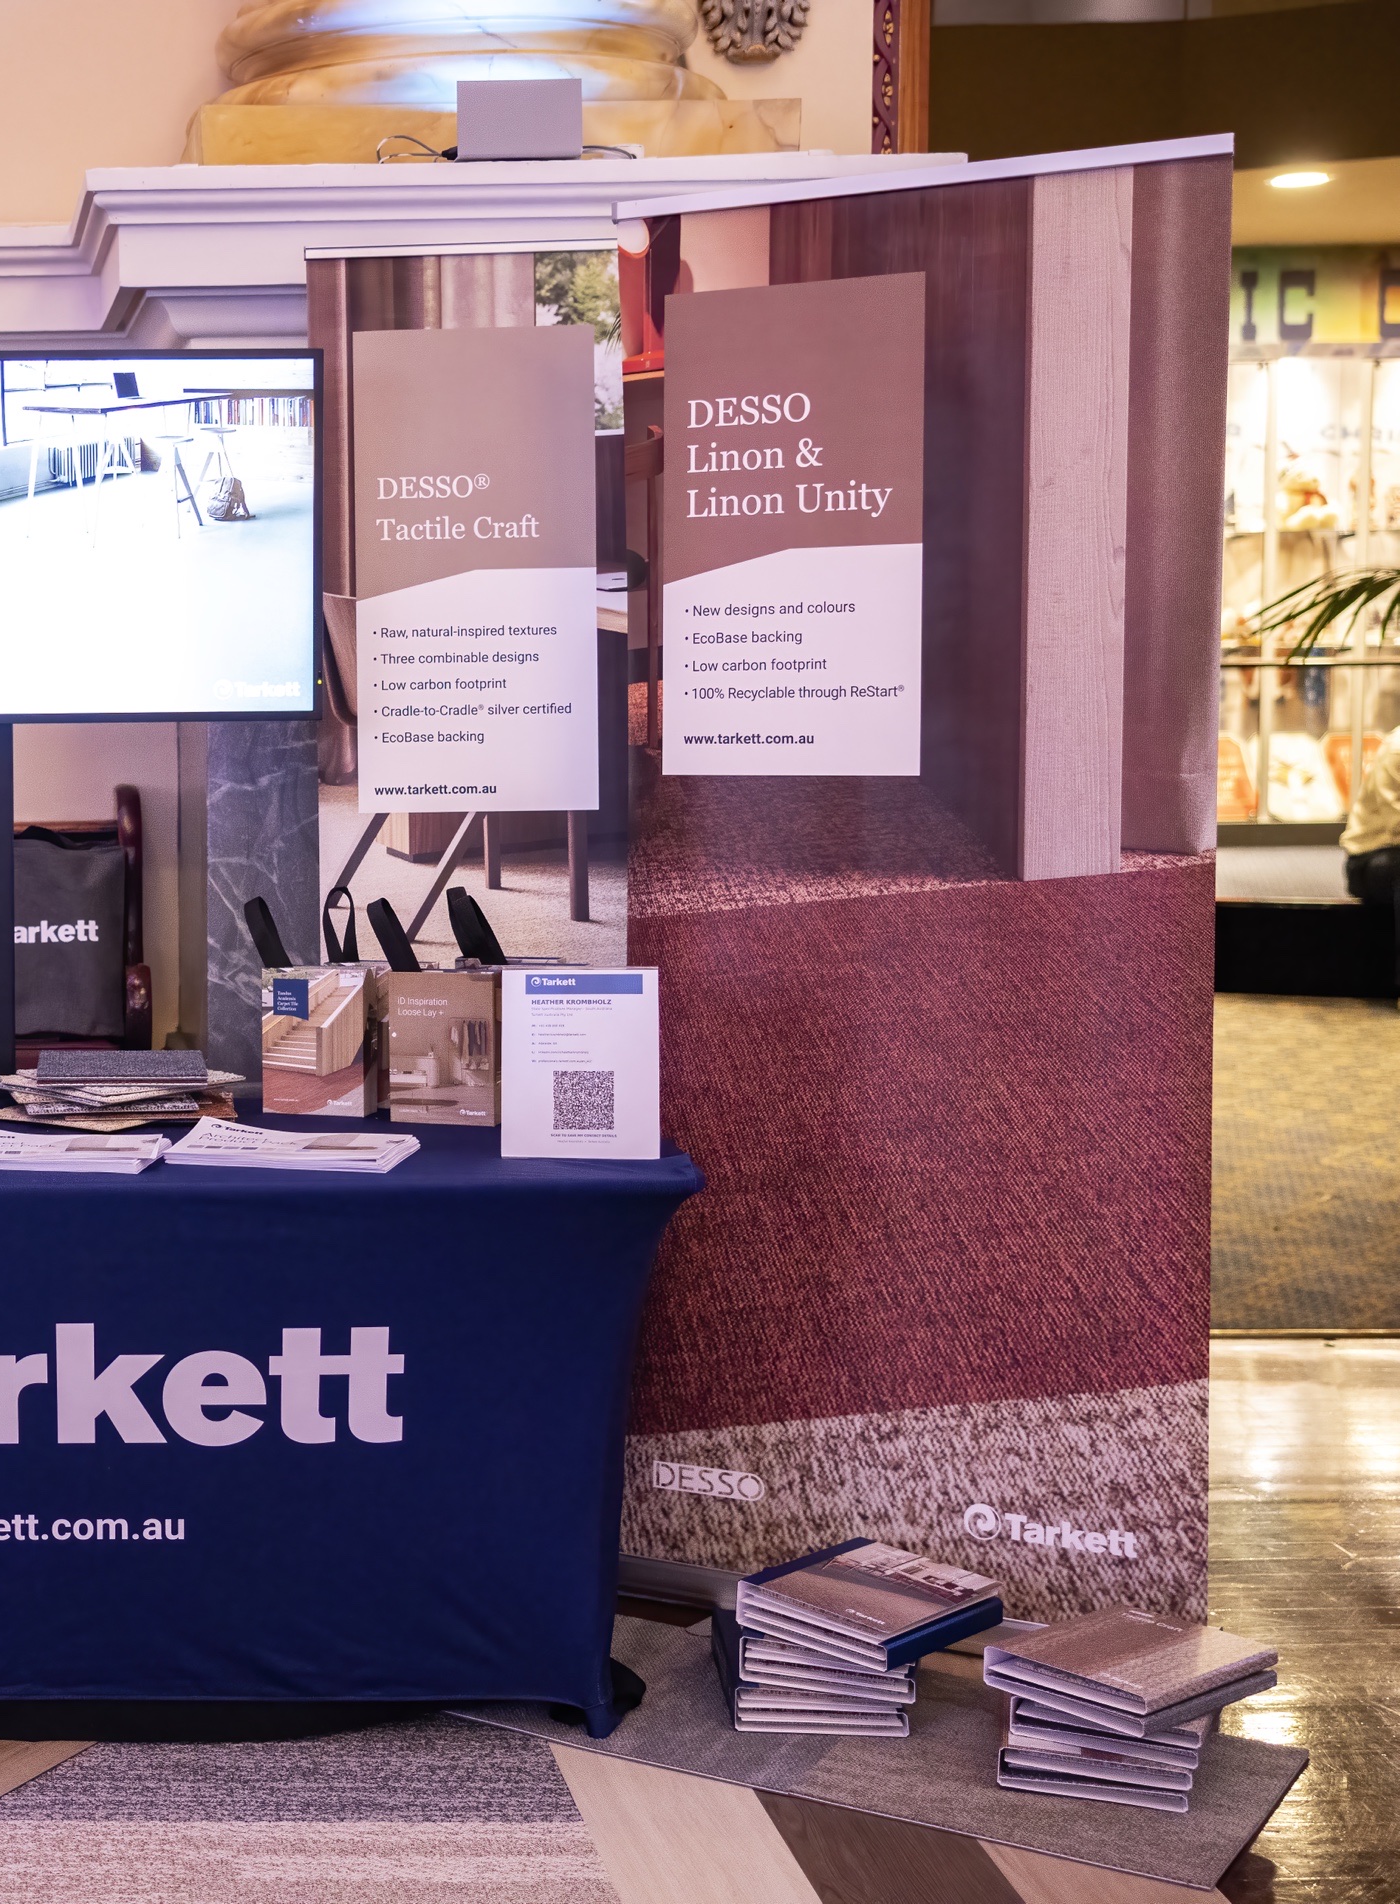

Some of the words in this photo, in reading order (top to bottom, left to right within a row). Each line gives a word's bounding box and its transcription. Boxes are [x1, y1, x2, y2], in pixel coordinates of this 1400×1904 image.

[687, 392, 812, 430] DESSO
[686, 440, 786, 475] Linon
[795, 437, 824, 468] &
[686, 485, 785, 519] Linon
[795, 480, 894, 518] Unity
[376, 516, 466, 542] Tactile
[473, 513, 540, 540] Craft
[692, 603, 721, 618] New
[724, 602, 777, 620] designs
[779, 602, 804, 617] and
[806, 600, 856, 616] colours
[380, 626, 409, 641] Raw,
[411, 624, 504, 641] natural-inspired
[508, 624, 557, 638] textures
[692, 631, 748, 646] EcoBase
[751, 629, 803, 648] backing
[380, 652, 414, 666] Three
[418, 651, 489, 665] combinable
[492, 650, 540, 667] designs
[692, 659, 718, 673] Low
[721, 658, 768, 673] carbon
[771, 656, 828, 675] footprint
[381, 678, 406, 692] Low
[409, 677, 452, 691] carbon
[454, 676, 508, 693] footprint
[691, 687, 725, 702] 100%
[728, 685, 796, 704] Recyclable
[798, 684, 848, 702] through
[487, 702, 520, 717] silver
[523, 702, 573, 716] certified
[381, 731, 434, 745] EcoBase
[437, 729, 486, 747] backing
[683, 732, 816, 748] www.tarkett.com.au
[374, 781, 498, 797] www.tarkett.com.au
[14, 919, 99, 944] arkett
[542, 977, 576, 986] Tarkett
[407, 997, 448, 1007] Inspiration
[397, 1007, 422, 1016] Loose
[423, 1008, 437, 1018] Lay
[223, 1126, 264, 1136] Tarkett
[654, 1460, 764, 1501] DESSO
[1004, 1511, 1138, 1560] Tarkett
